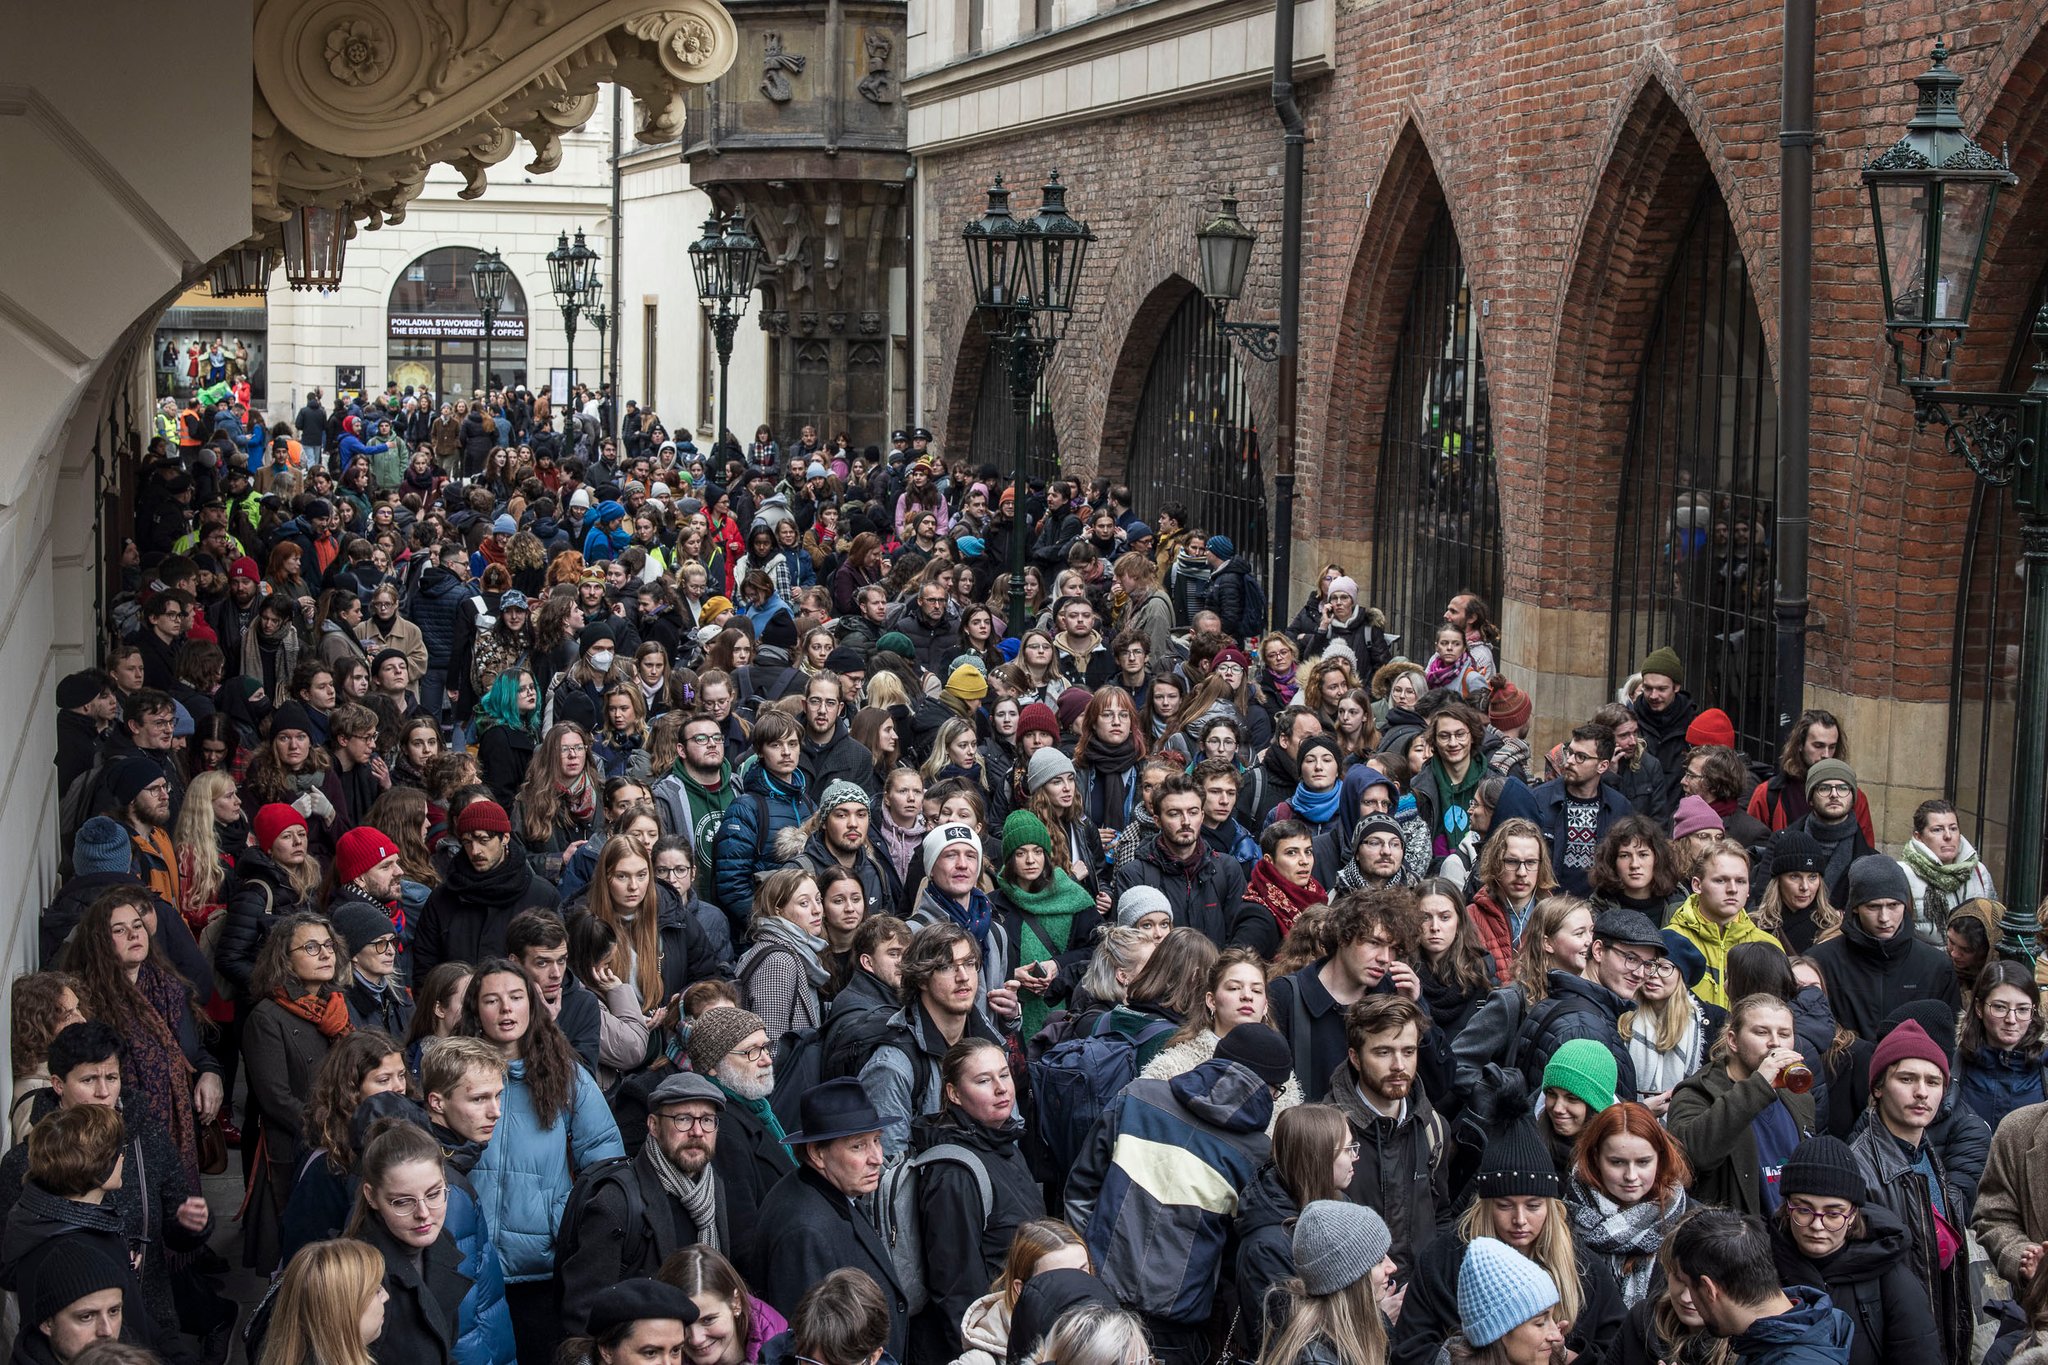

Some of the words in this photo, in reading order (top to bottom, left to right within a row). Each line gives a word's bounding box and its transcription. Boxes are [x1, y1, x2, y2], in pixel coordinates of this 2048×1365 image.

[391, 319, 433, 327] POKLADNA
[435, 319, 486, 327] STAVOVSKÉH
[391, 327, 407, 335] THE
[409, 327, 441, 335] ESTATES
[443, 328, 478, 336] THEATRE
[497, 328, 524, 337] OFFICE
